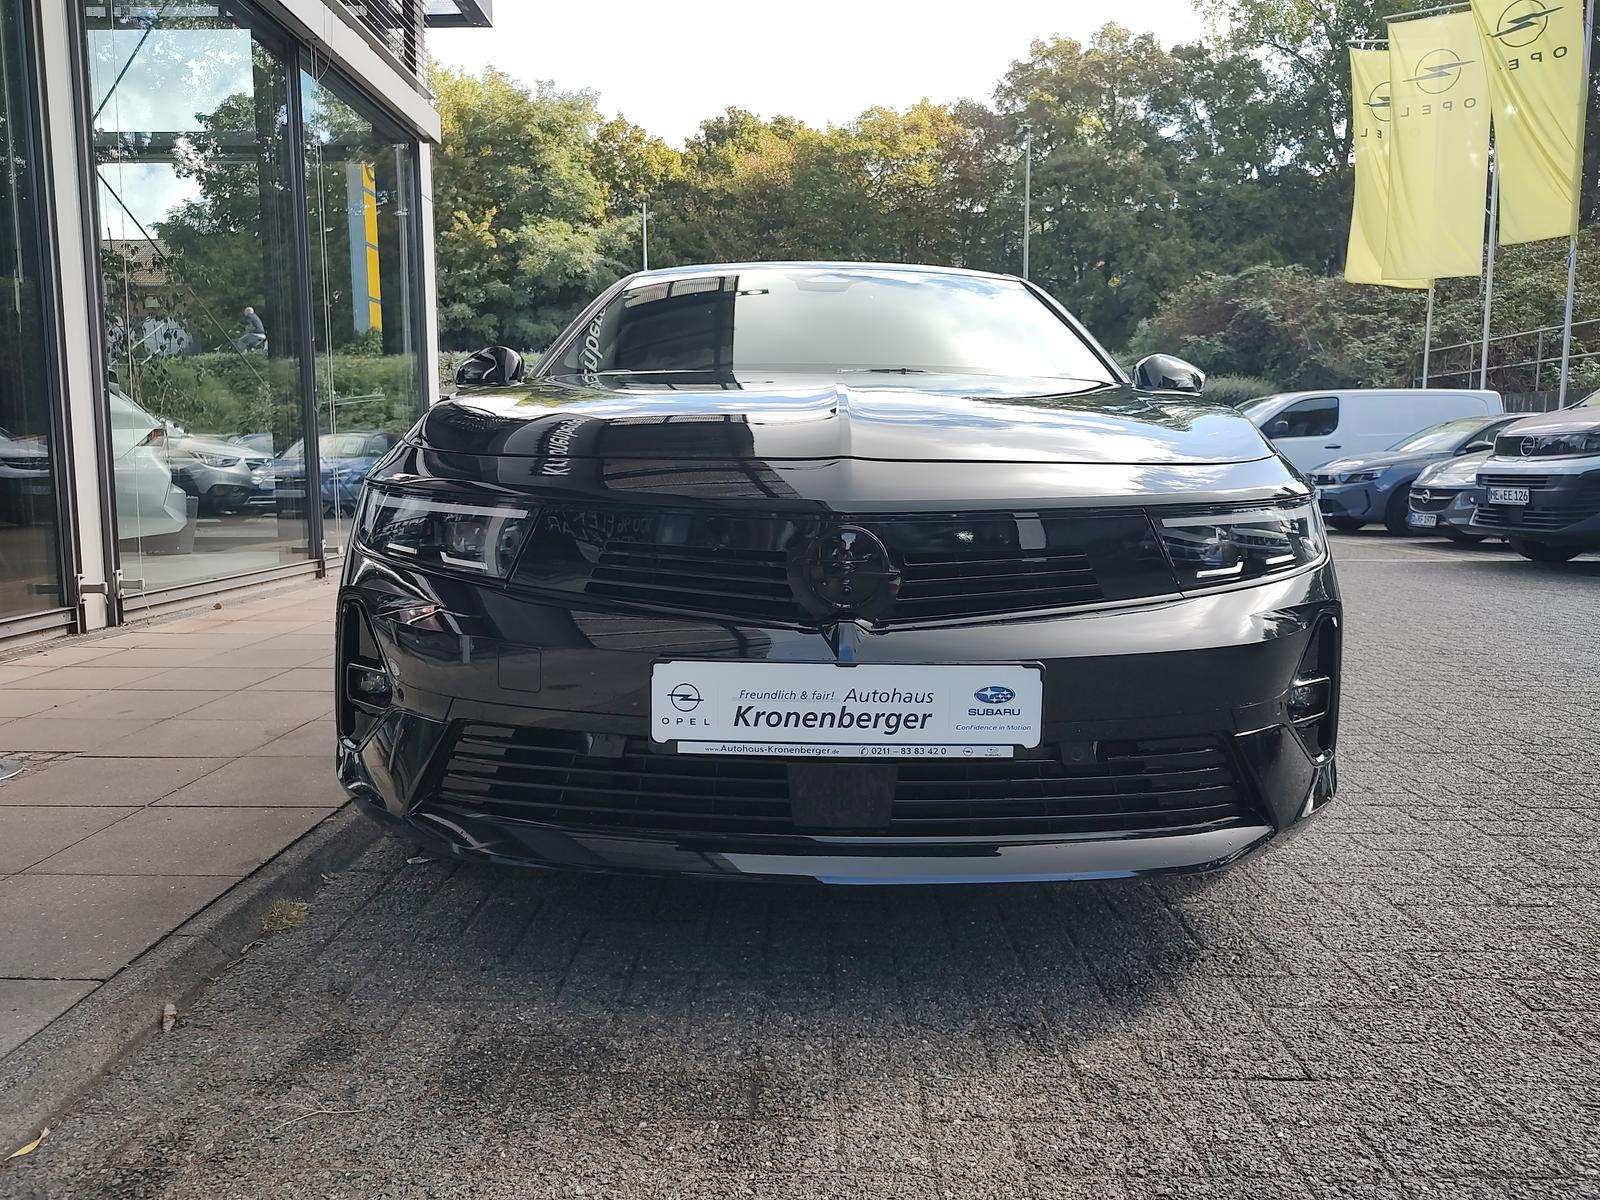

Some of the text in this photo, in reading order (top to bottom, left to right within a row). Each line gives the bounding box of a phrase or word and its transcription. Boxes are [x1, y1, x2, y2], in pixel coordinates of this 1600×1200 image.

[1514, 490, 1528, 502] 126
[739, 688, 934, 704] Freundlich & fair! Autohaus
[968, 708, 1021, 716] SUBARU
[661, 717, 710, 726] OPEL
[733, 705, 933, 735] Kronenberger
[871, 747, 891, 755] 0211
[900, 747, 913, 755] 83
[914, 747, 926, 755] 83
